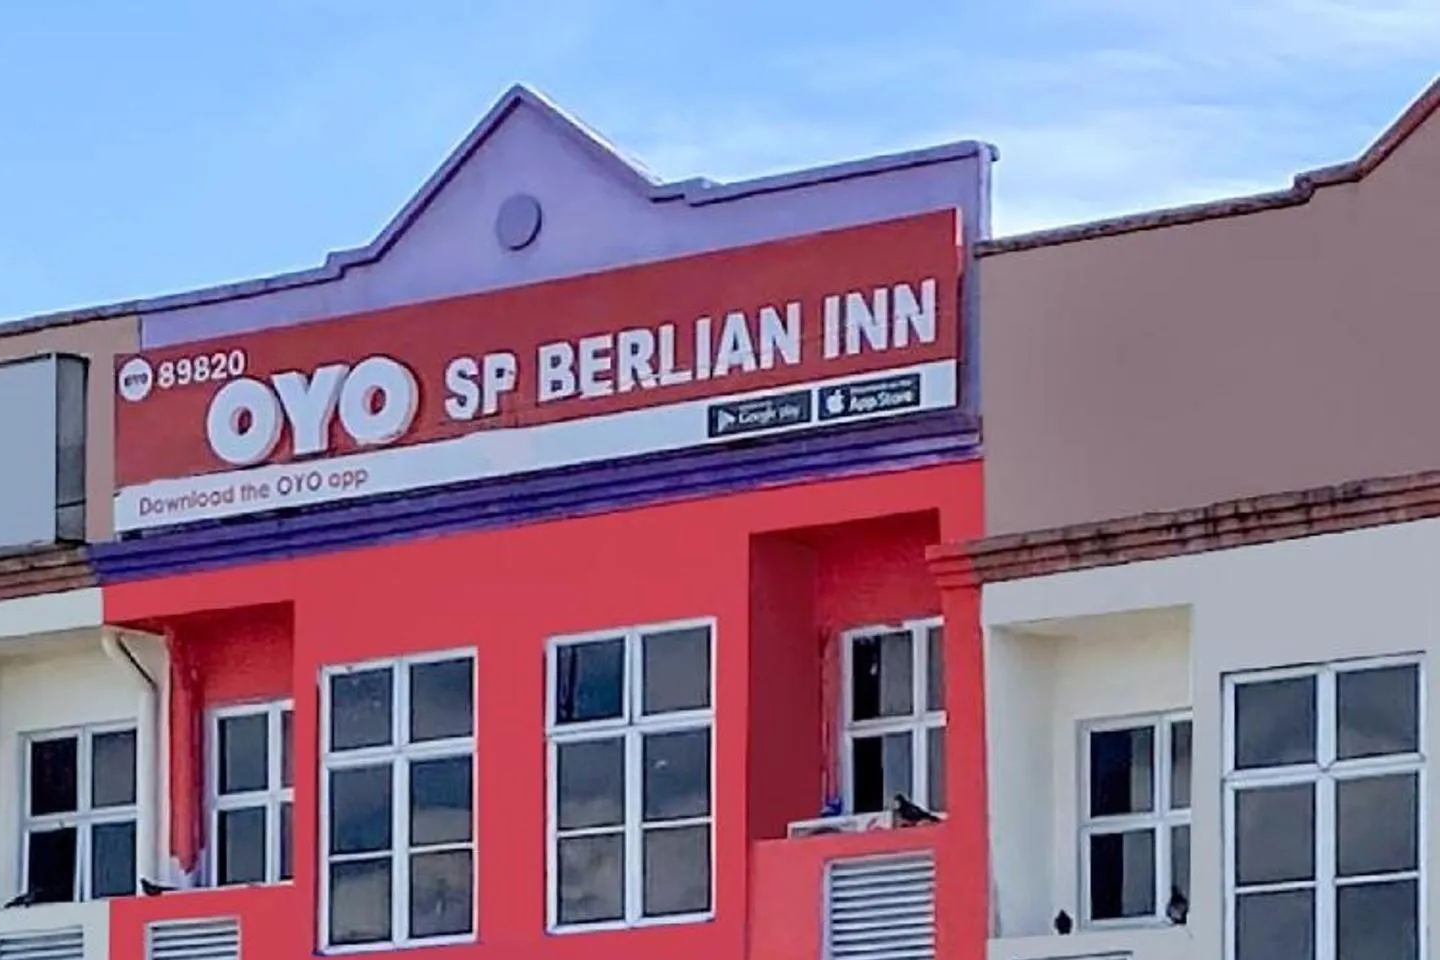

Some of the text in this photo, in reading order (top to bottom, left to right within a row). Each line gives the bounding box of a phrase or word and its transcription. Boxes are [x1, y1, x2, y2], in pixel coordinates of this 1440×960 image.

[158, 350, 246, 388] 89820
[443, 278, 937, 421] SP BERLIAN INN
[207, 356, 419, 465] OYO
[138, 469, 370, 516] Download the OYO app
